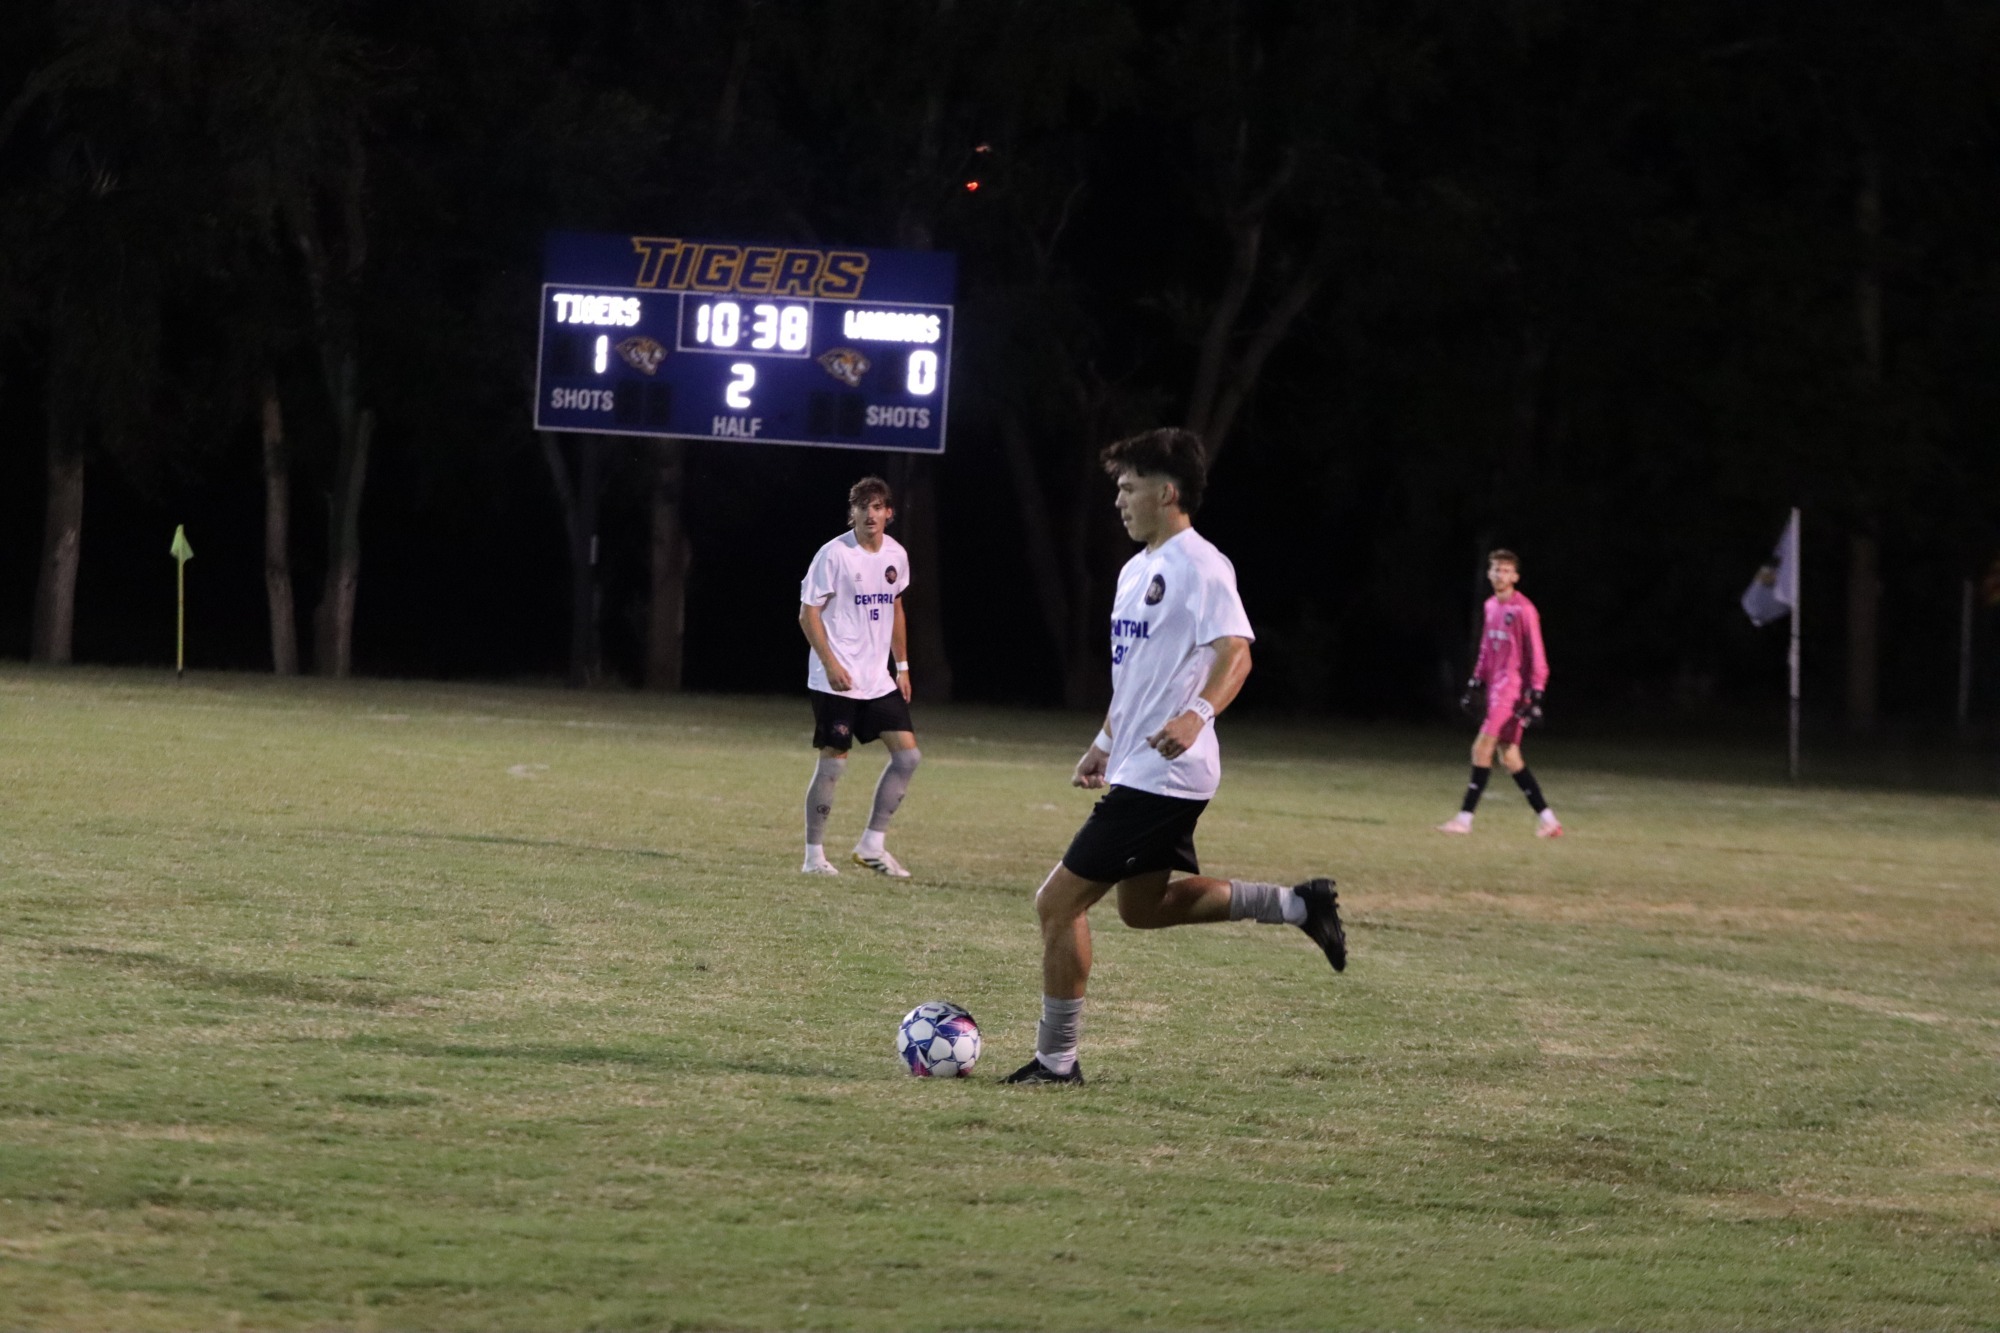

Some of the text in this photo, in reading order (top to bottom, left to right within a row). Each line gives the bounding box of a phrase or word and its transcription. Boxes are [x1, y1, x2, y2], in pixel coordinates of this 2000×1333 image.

[632, 236, 869, 298] TIGERS
[552, 293, 641, 327] TIGERS
[696, 302, 809, 351] 10:38
[594, 335, 608, 374] 1
[725, 363, 756, 409] 2
[906, 349, 938, 395] 0
[551, 387, 614, 411] SHOTS
[712, 416, 763, 438] HALF
[866, 405, 931, 429] SHOTS
[854, 593, 894, 606] CENTRAL
[870, 608, 880, 621] 15
